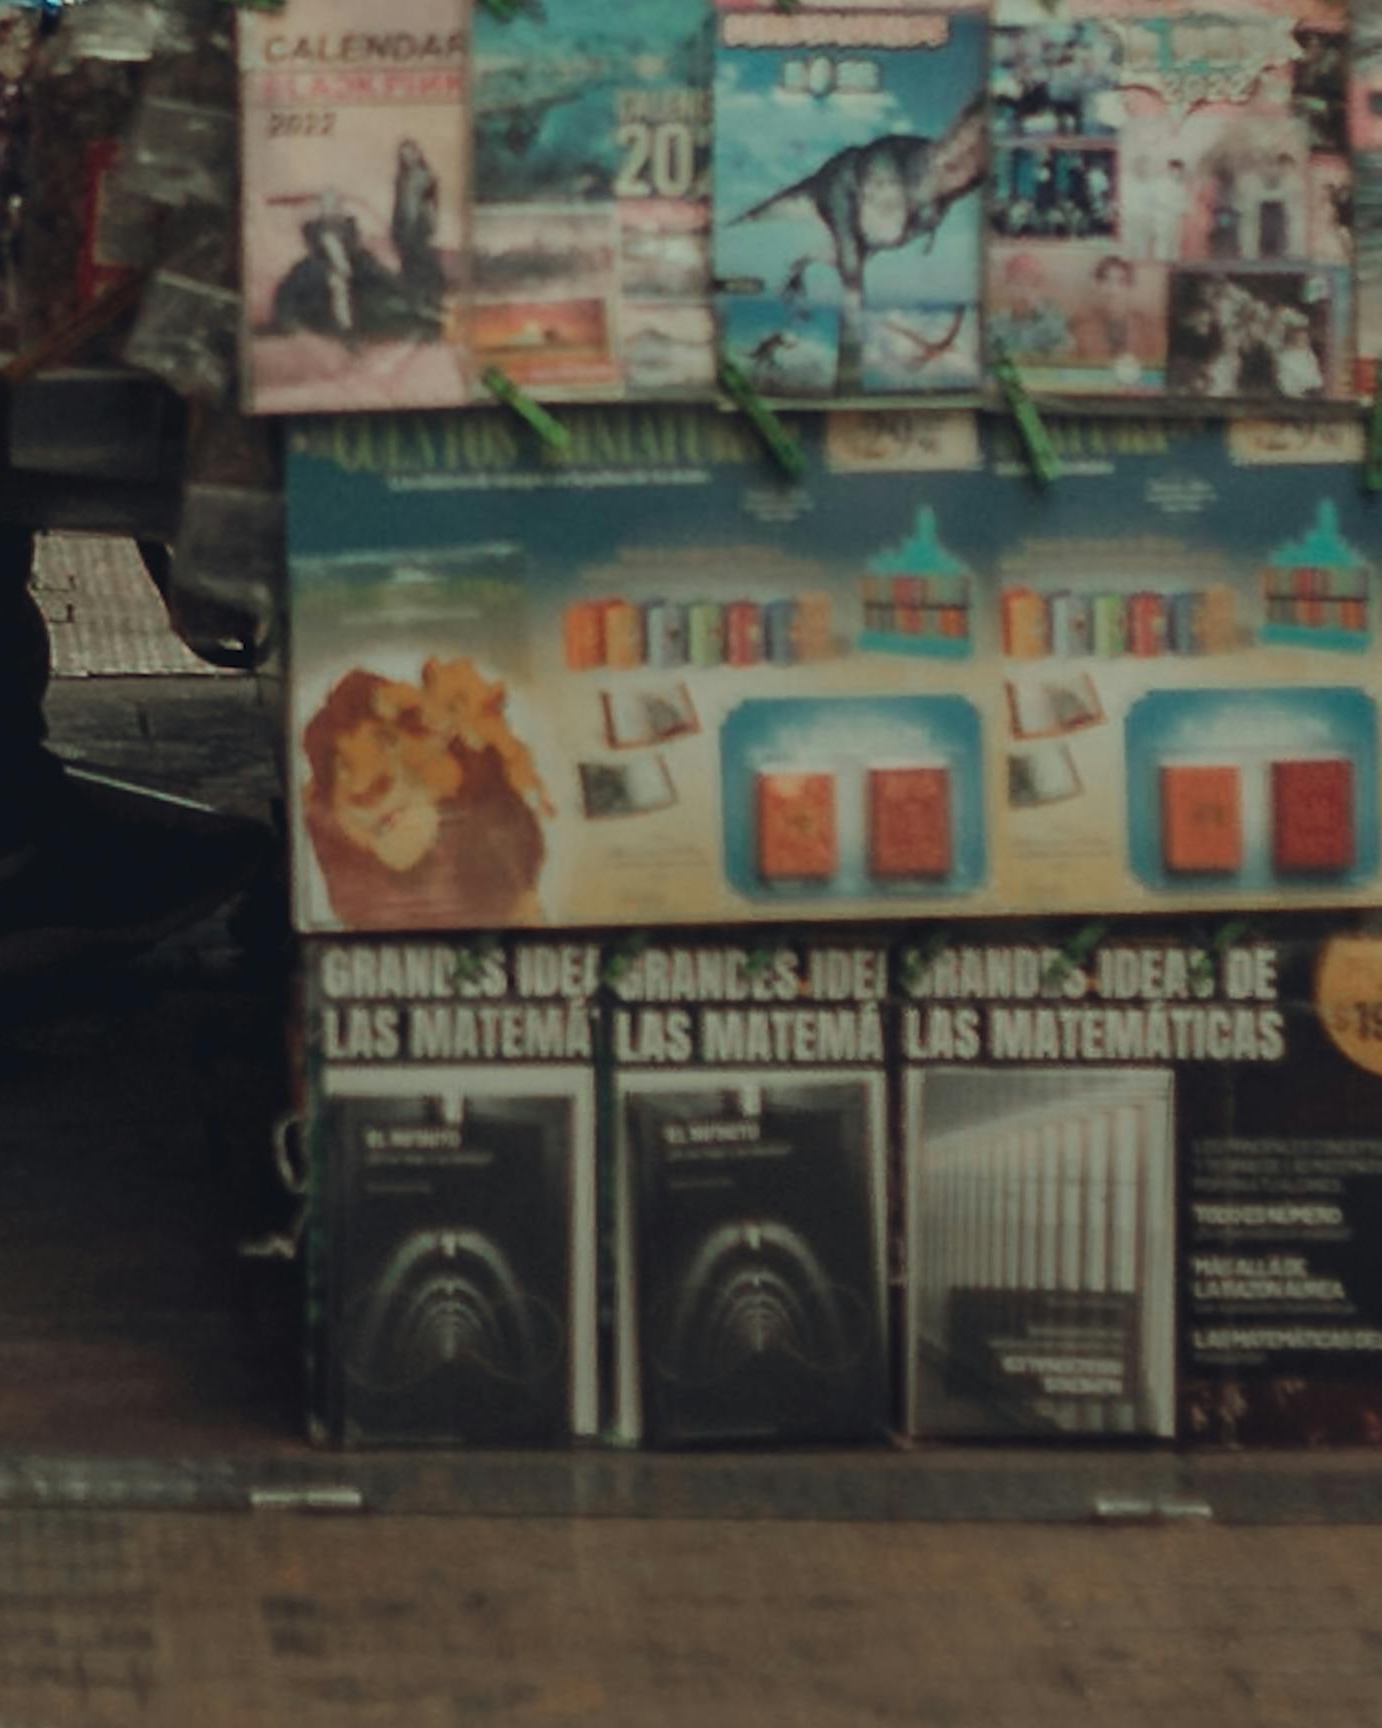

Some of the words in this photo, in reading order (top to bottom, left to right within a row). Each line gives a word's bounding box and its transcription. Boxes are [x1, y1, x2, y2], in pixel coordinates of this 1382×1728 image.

[1228, 947, 1278, 999] DE
[324, 1007, 400, 1058] LAS
[614, 1009, 693, 1062] LAS
[904, 1007, 980, 1059] LAS
[992, 998, 1285, 1060] MATEMÁTICAS
